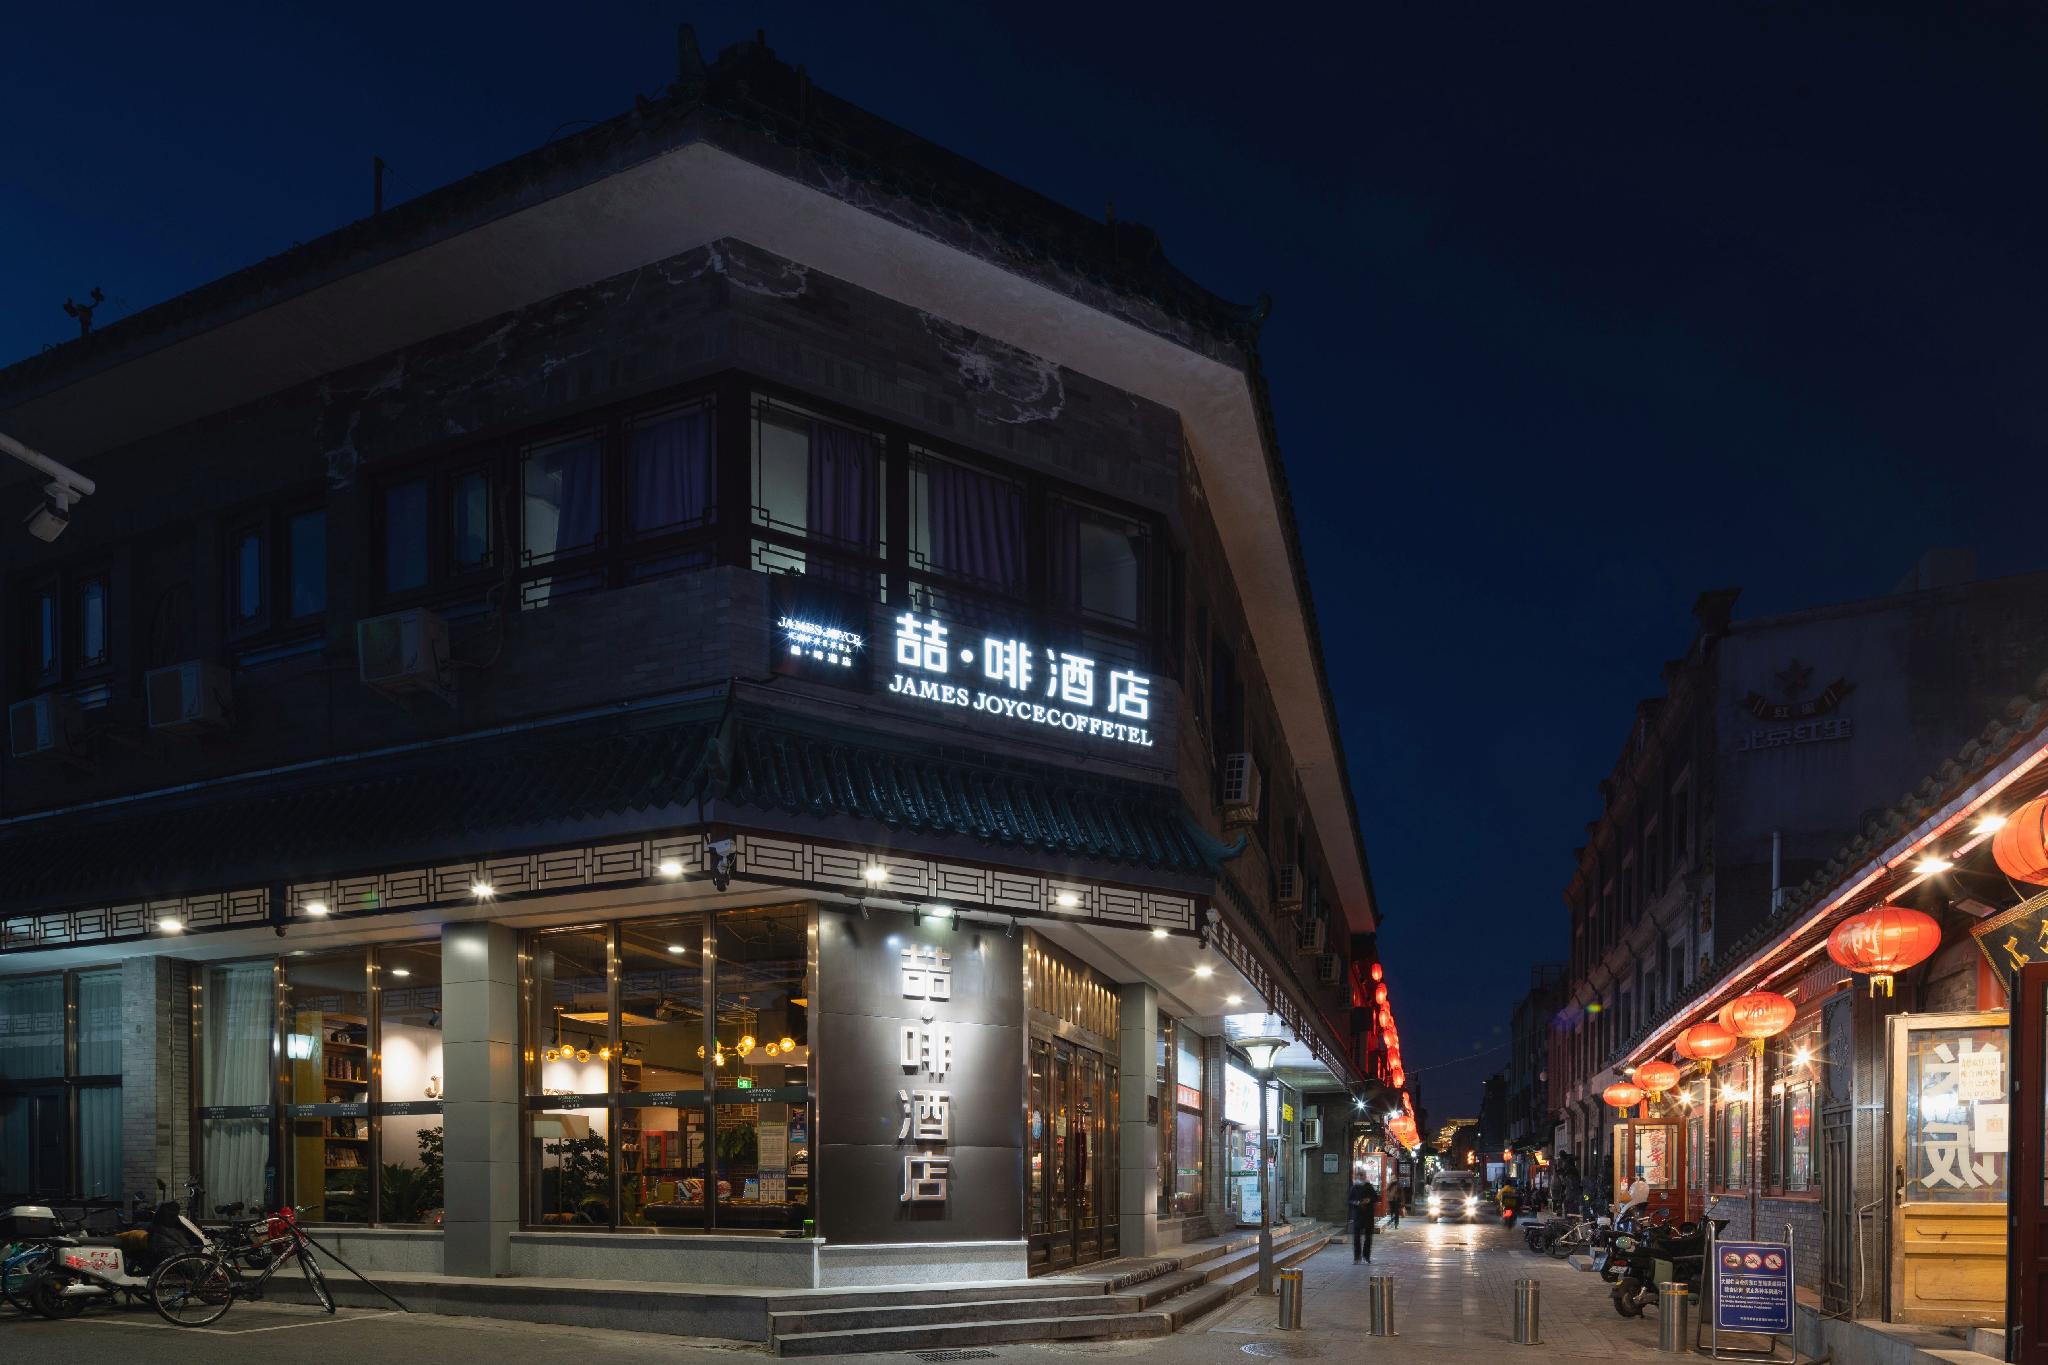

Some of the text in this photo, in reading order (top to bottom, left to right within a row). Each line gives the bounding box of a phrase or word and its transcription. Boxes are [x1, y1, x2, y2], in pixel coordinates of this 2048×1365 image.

[889, 675, 970, 707] JAMES
[1737, 718, 1854, 752] 北京红星
[899, 944, 951, 1202] 喆·啡酒店
